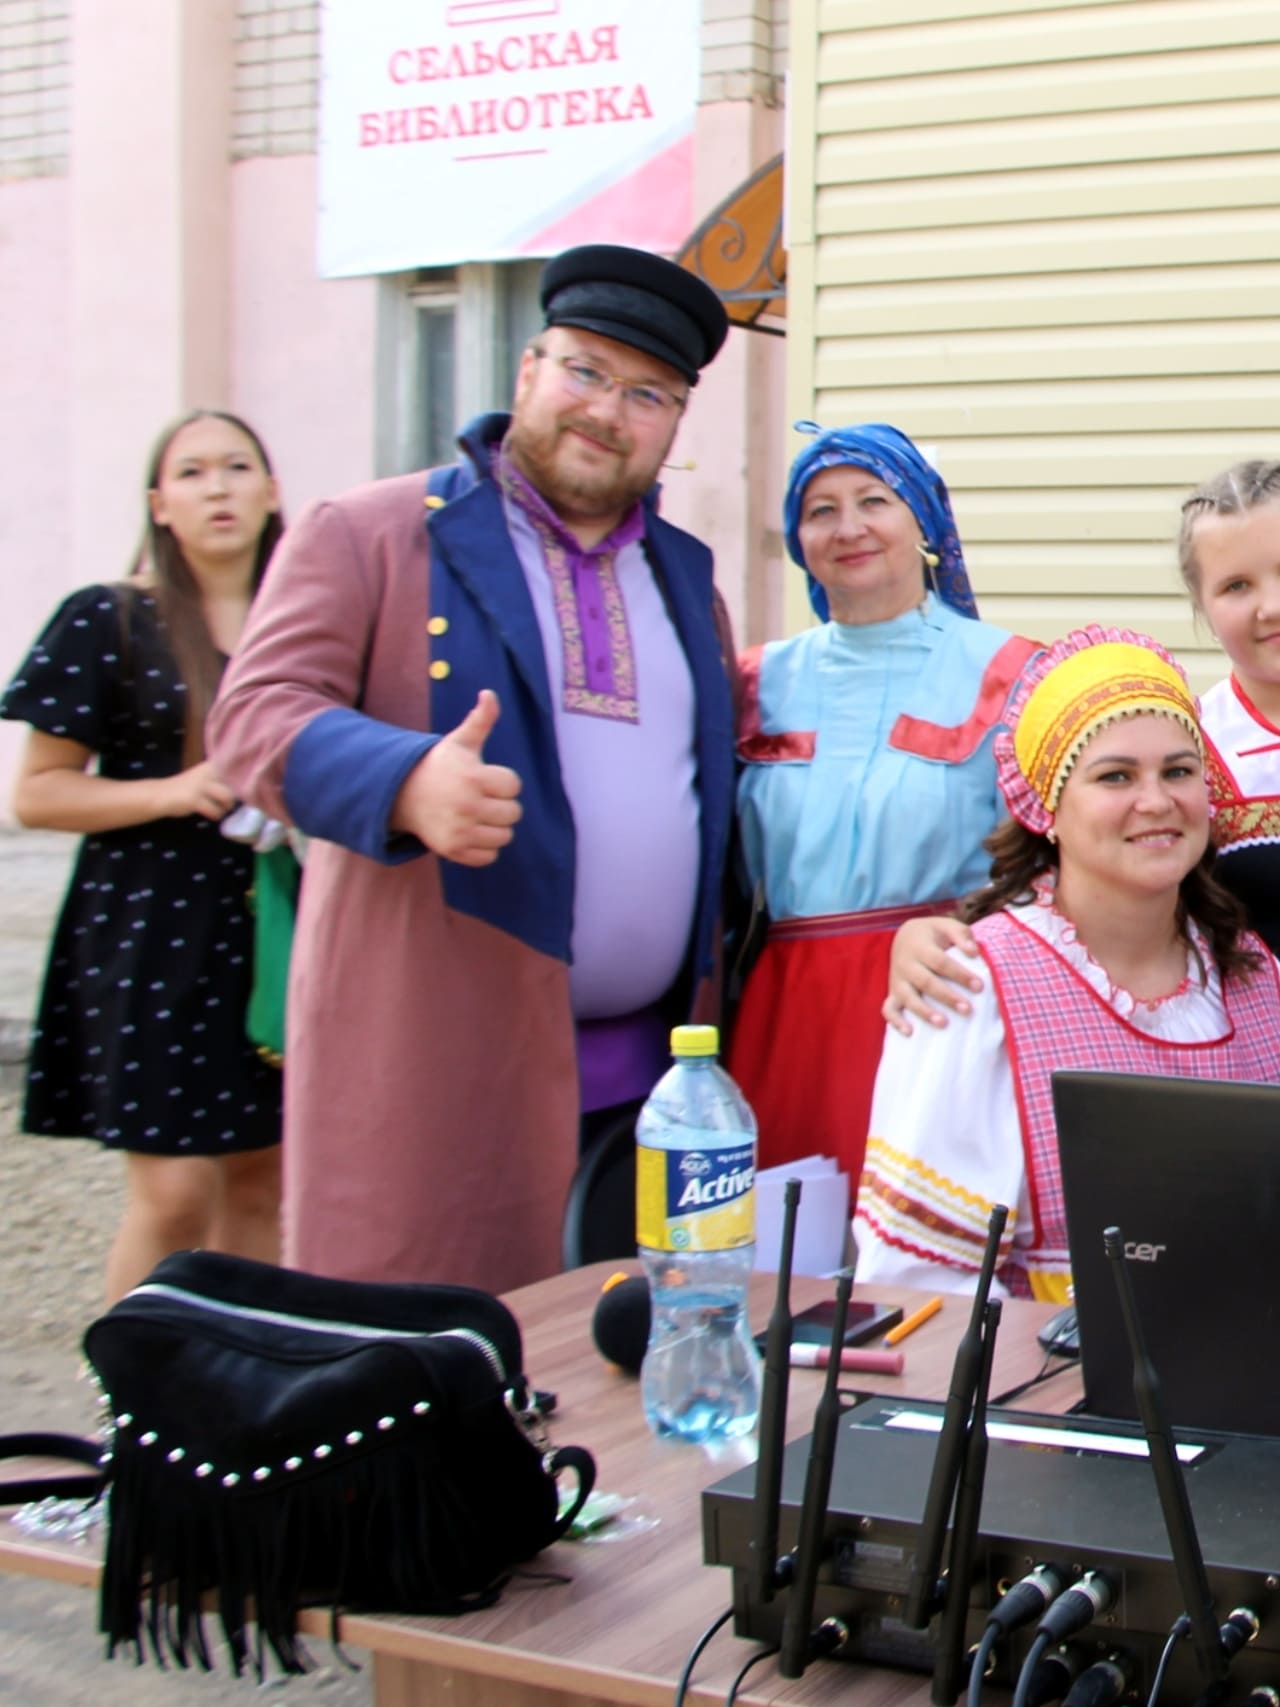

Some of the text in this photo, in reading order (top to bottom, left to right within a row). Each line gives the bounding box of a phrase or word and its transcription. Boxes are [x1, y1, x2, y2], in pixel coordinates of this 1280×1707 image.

[388, 25, 620, 85] СЕЛЬСКАЯ
[358, 83, 655, 148] БИБЛИОТЕКА
[1123, 1241, 1167, 1262] cer
